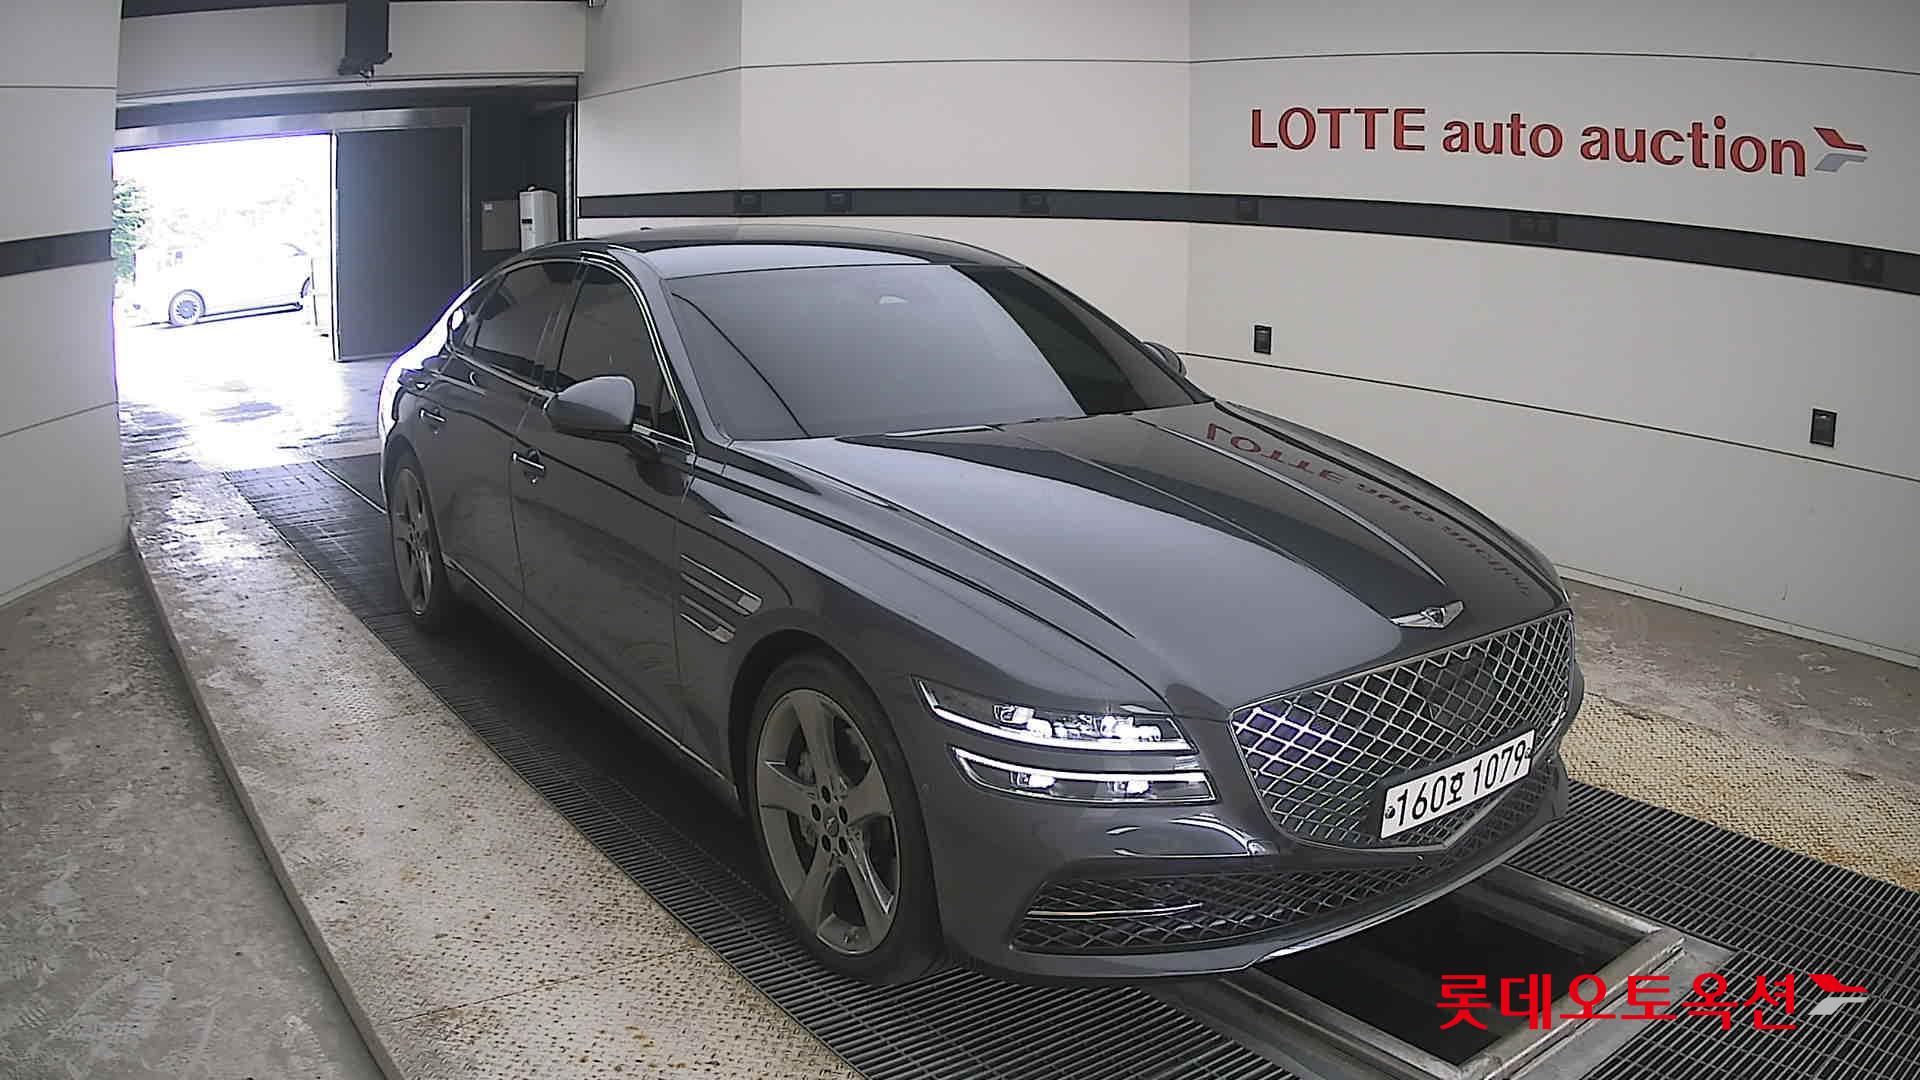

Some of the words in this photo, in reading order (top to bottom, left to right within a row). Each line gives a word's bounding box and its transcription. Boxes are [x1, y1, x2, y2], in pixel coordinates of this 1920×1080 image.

[1251, 107, 1425, 151] LOTTE
[1442, 113, 1564, 158] auto
[1580, 115, 1807, 178] auction
[1397, 771, 1466, 827] 160호
[1472, 739, 1526, 796] 1079
